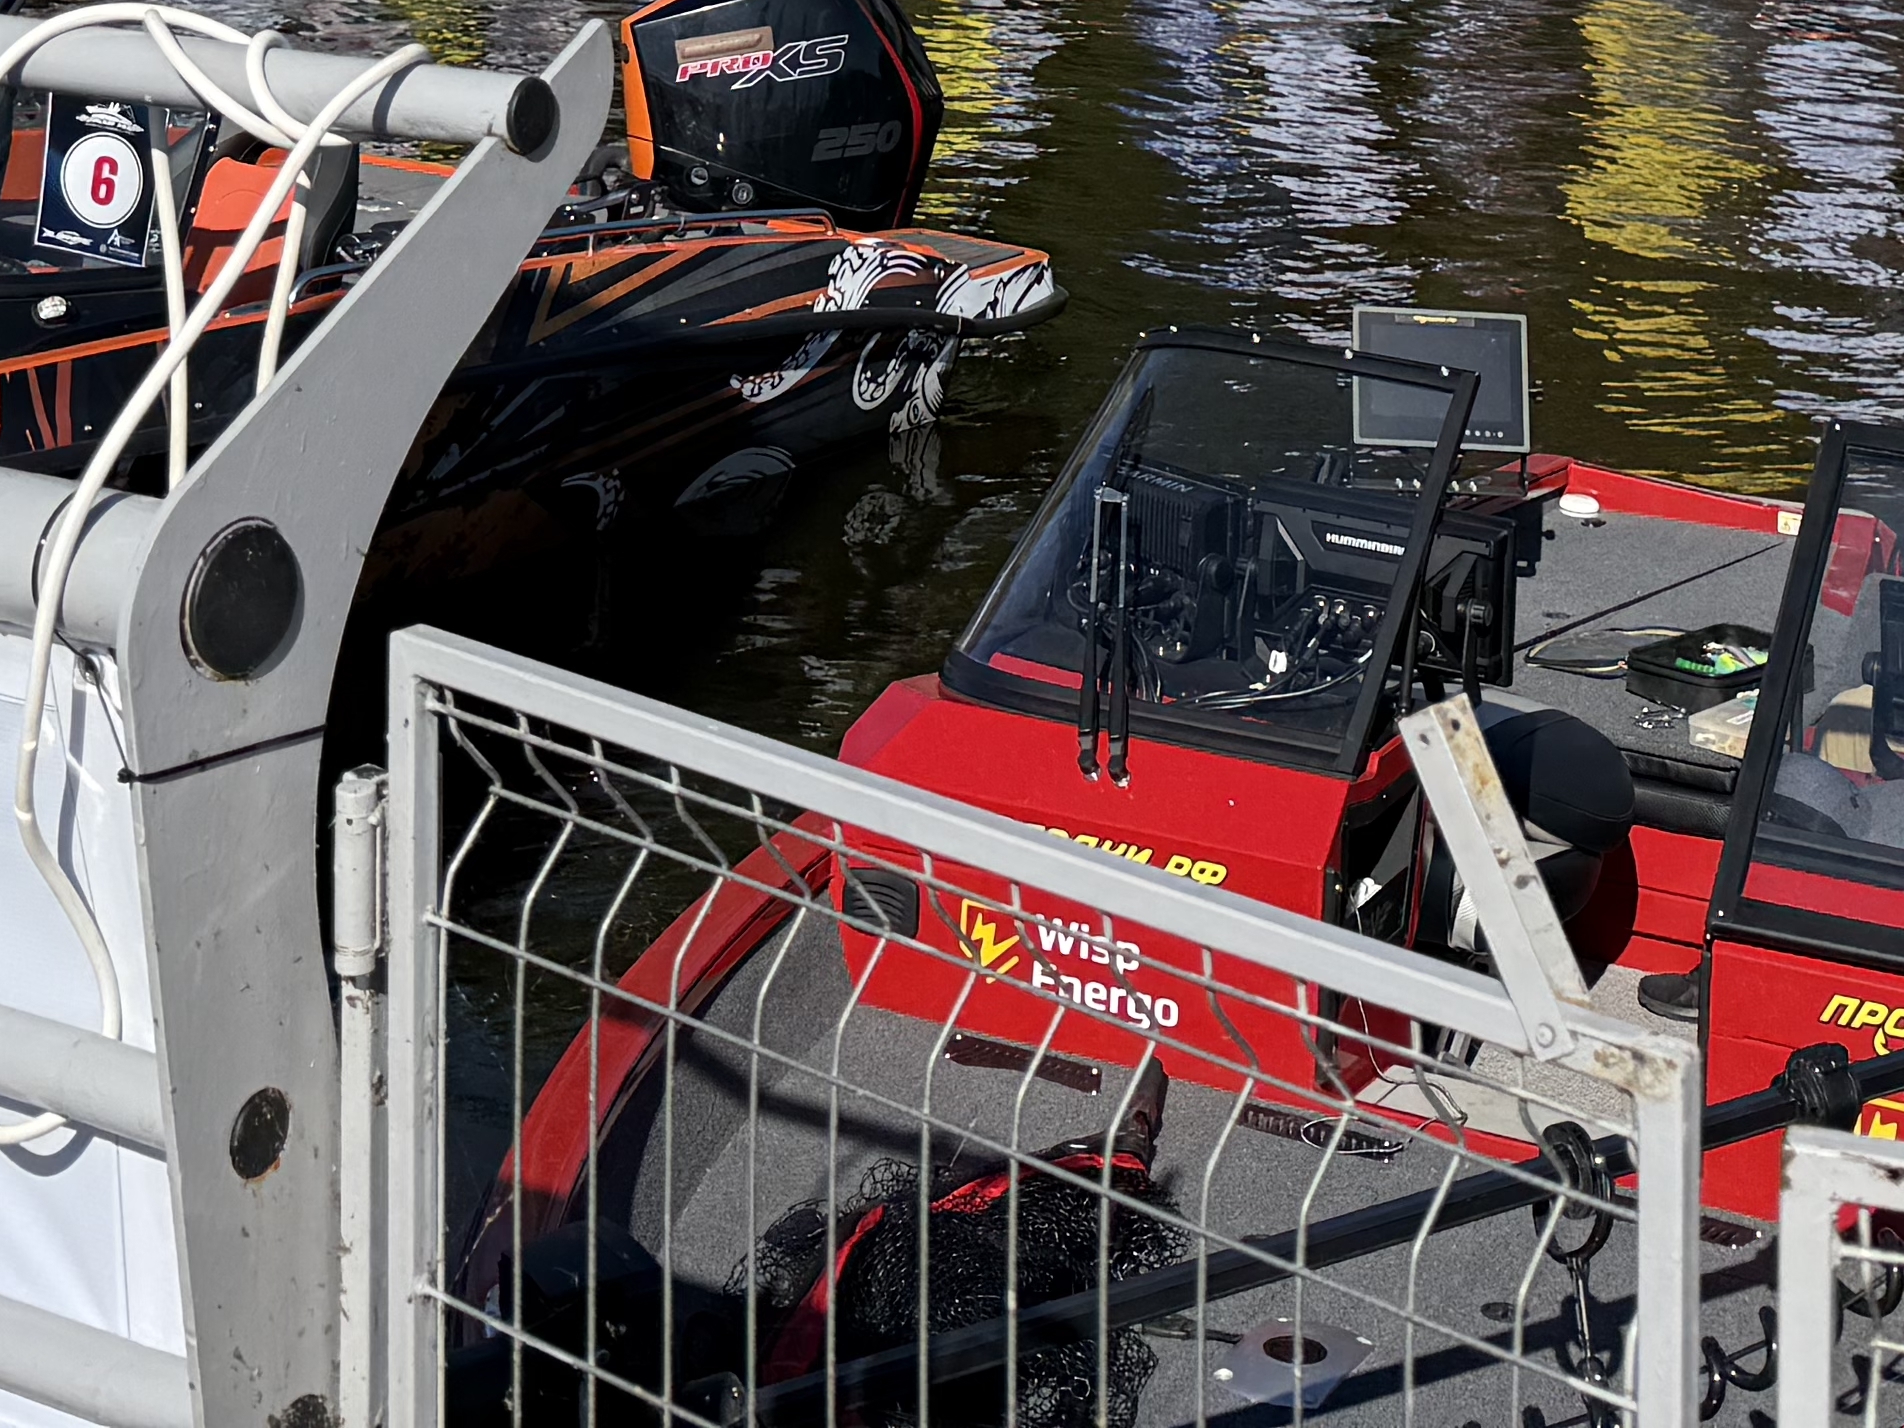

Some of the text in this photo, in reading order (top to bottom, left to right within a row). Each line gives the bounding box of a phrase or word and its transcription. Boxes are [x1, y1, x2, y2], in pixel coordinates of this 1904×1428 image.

[810, 119, 903, 163] 250
[90, 155, 119, 207] 6
[1034, 913, 1142, 976] Wisp
[1031, 959, 1180, 1030] Energo
